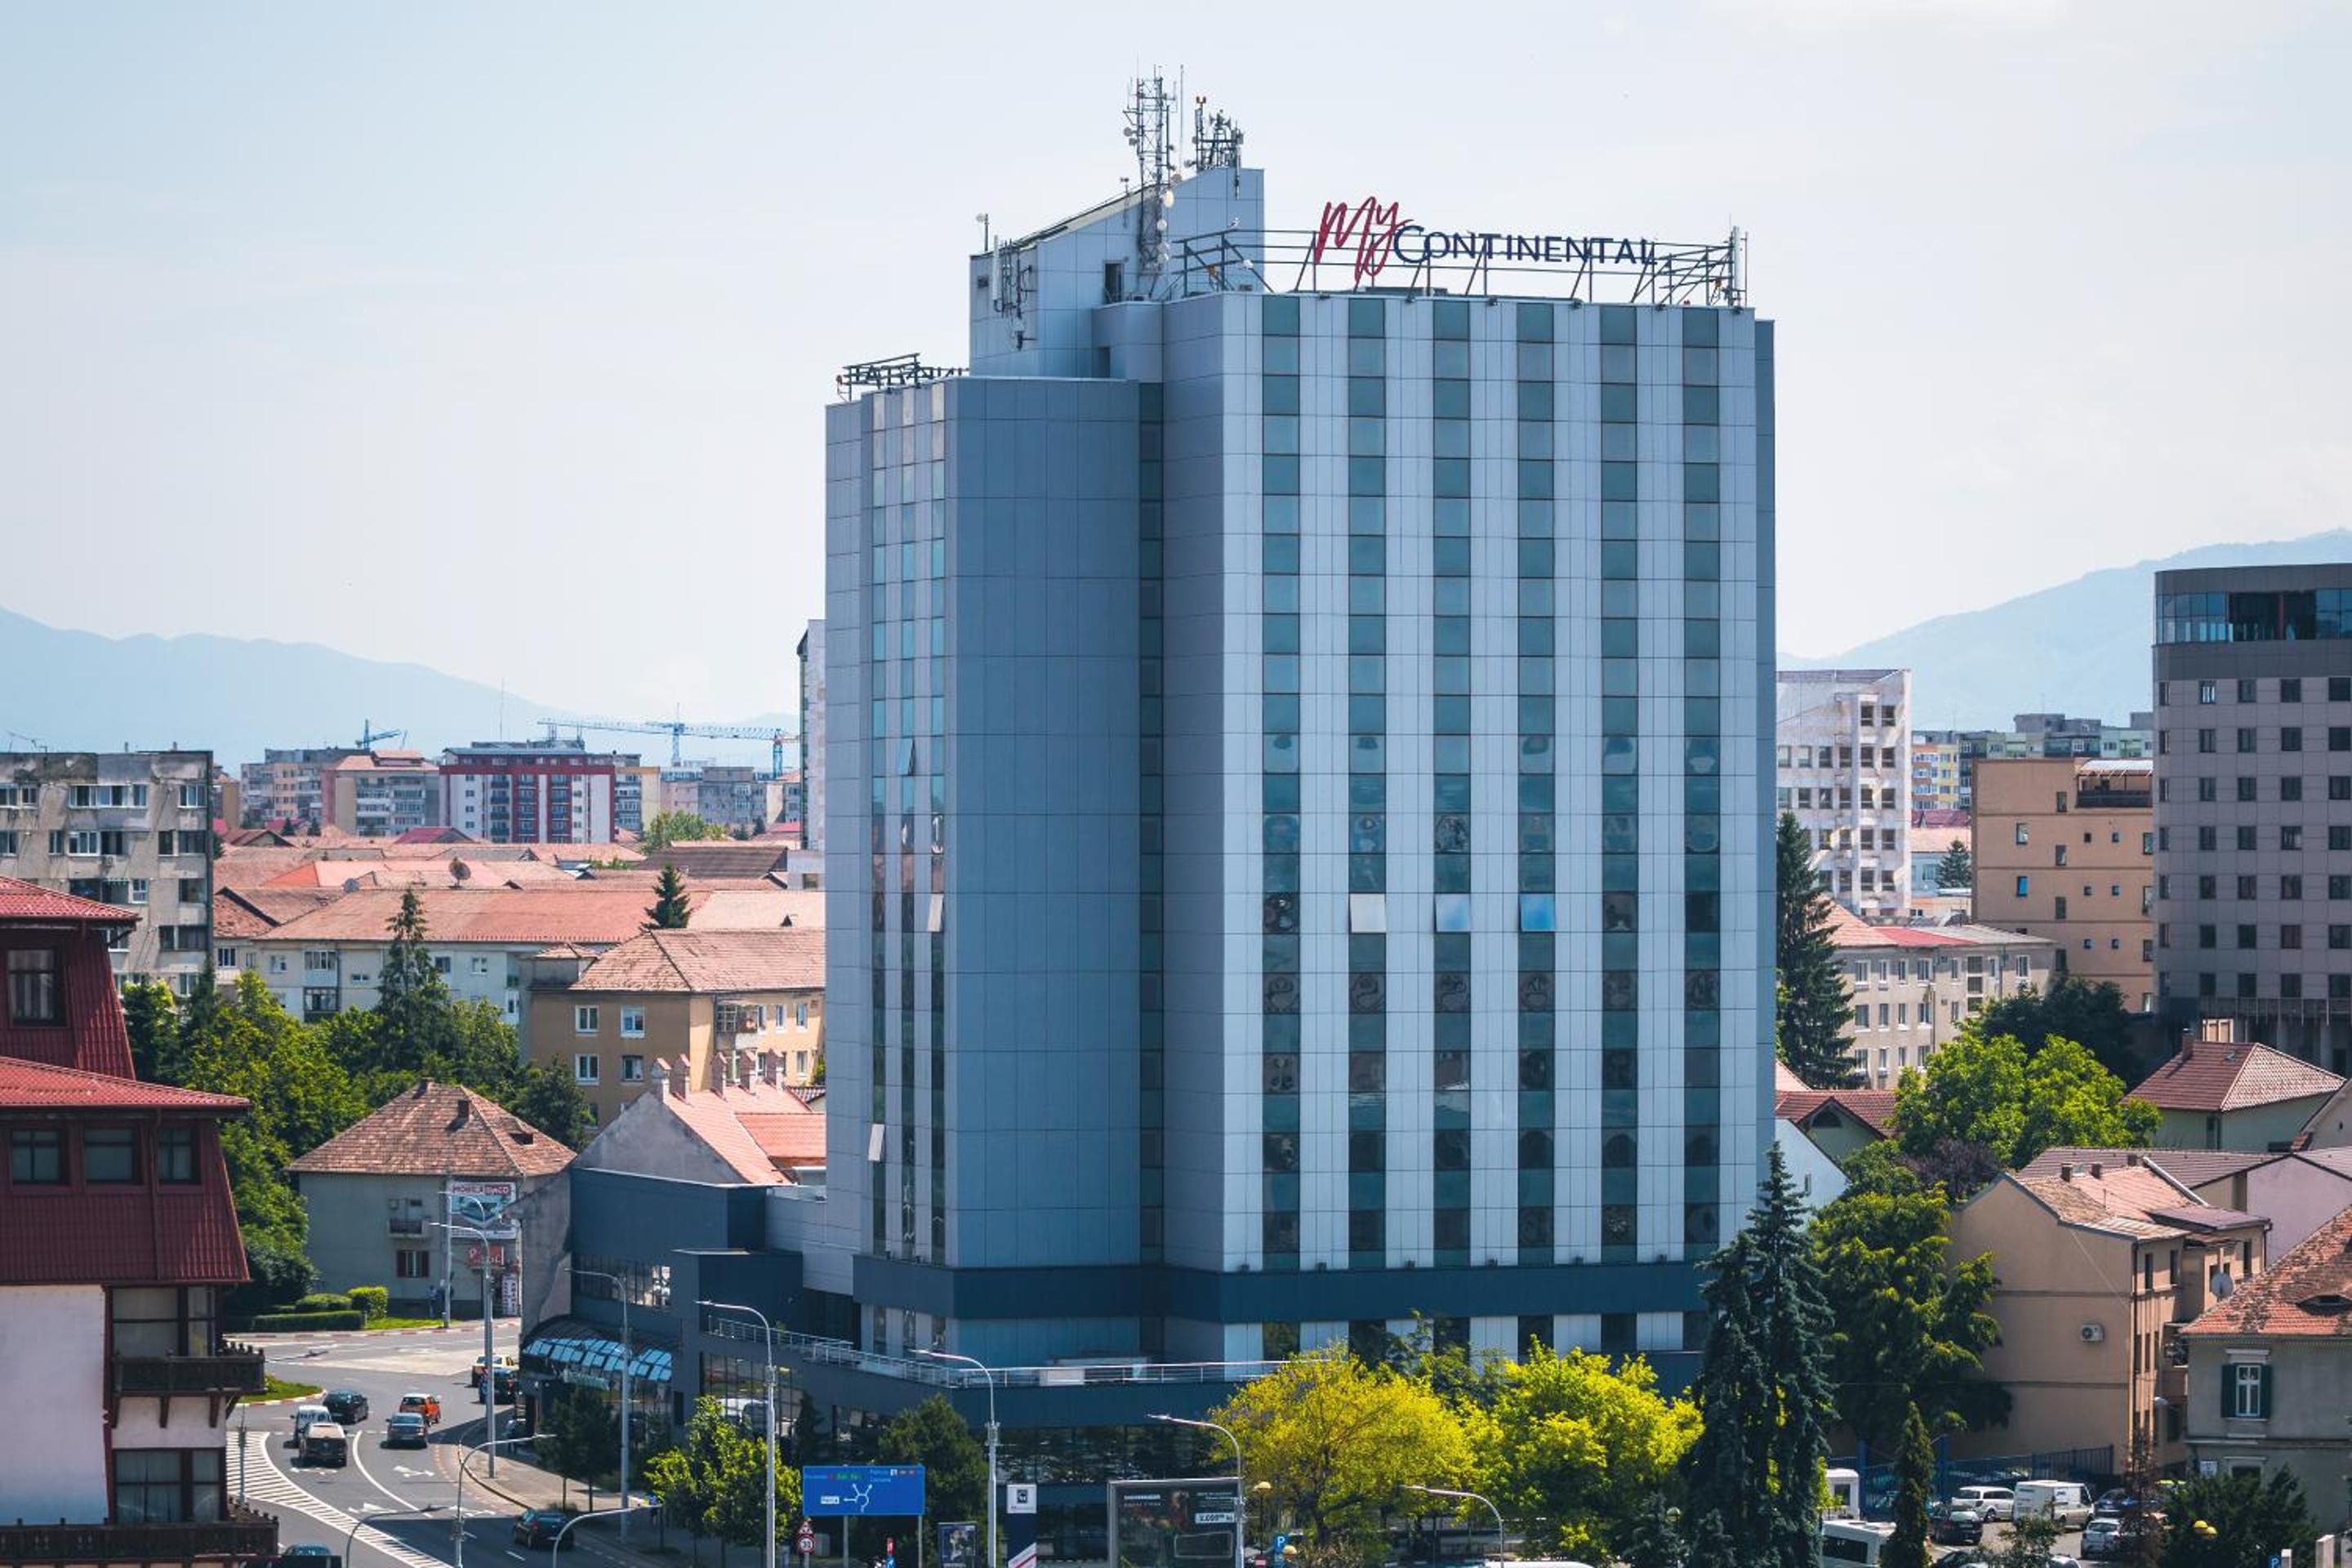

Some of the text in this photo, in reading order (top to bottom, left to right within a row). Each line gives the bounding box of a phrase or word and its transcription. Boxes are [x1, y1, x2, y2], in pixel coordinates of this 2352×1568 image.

[1314, 196, 1658, 283] My CONTINENTAL
[1277, 1535, 1285, 1548] P
[2271, 1557, 2279, 1568] P
